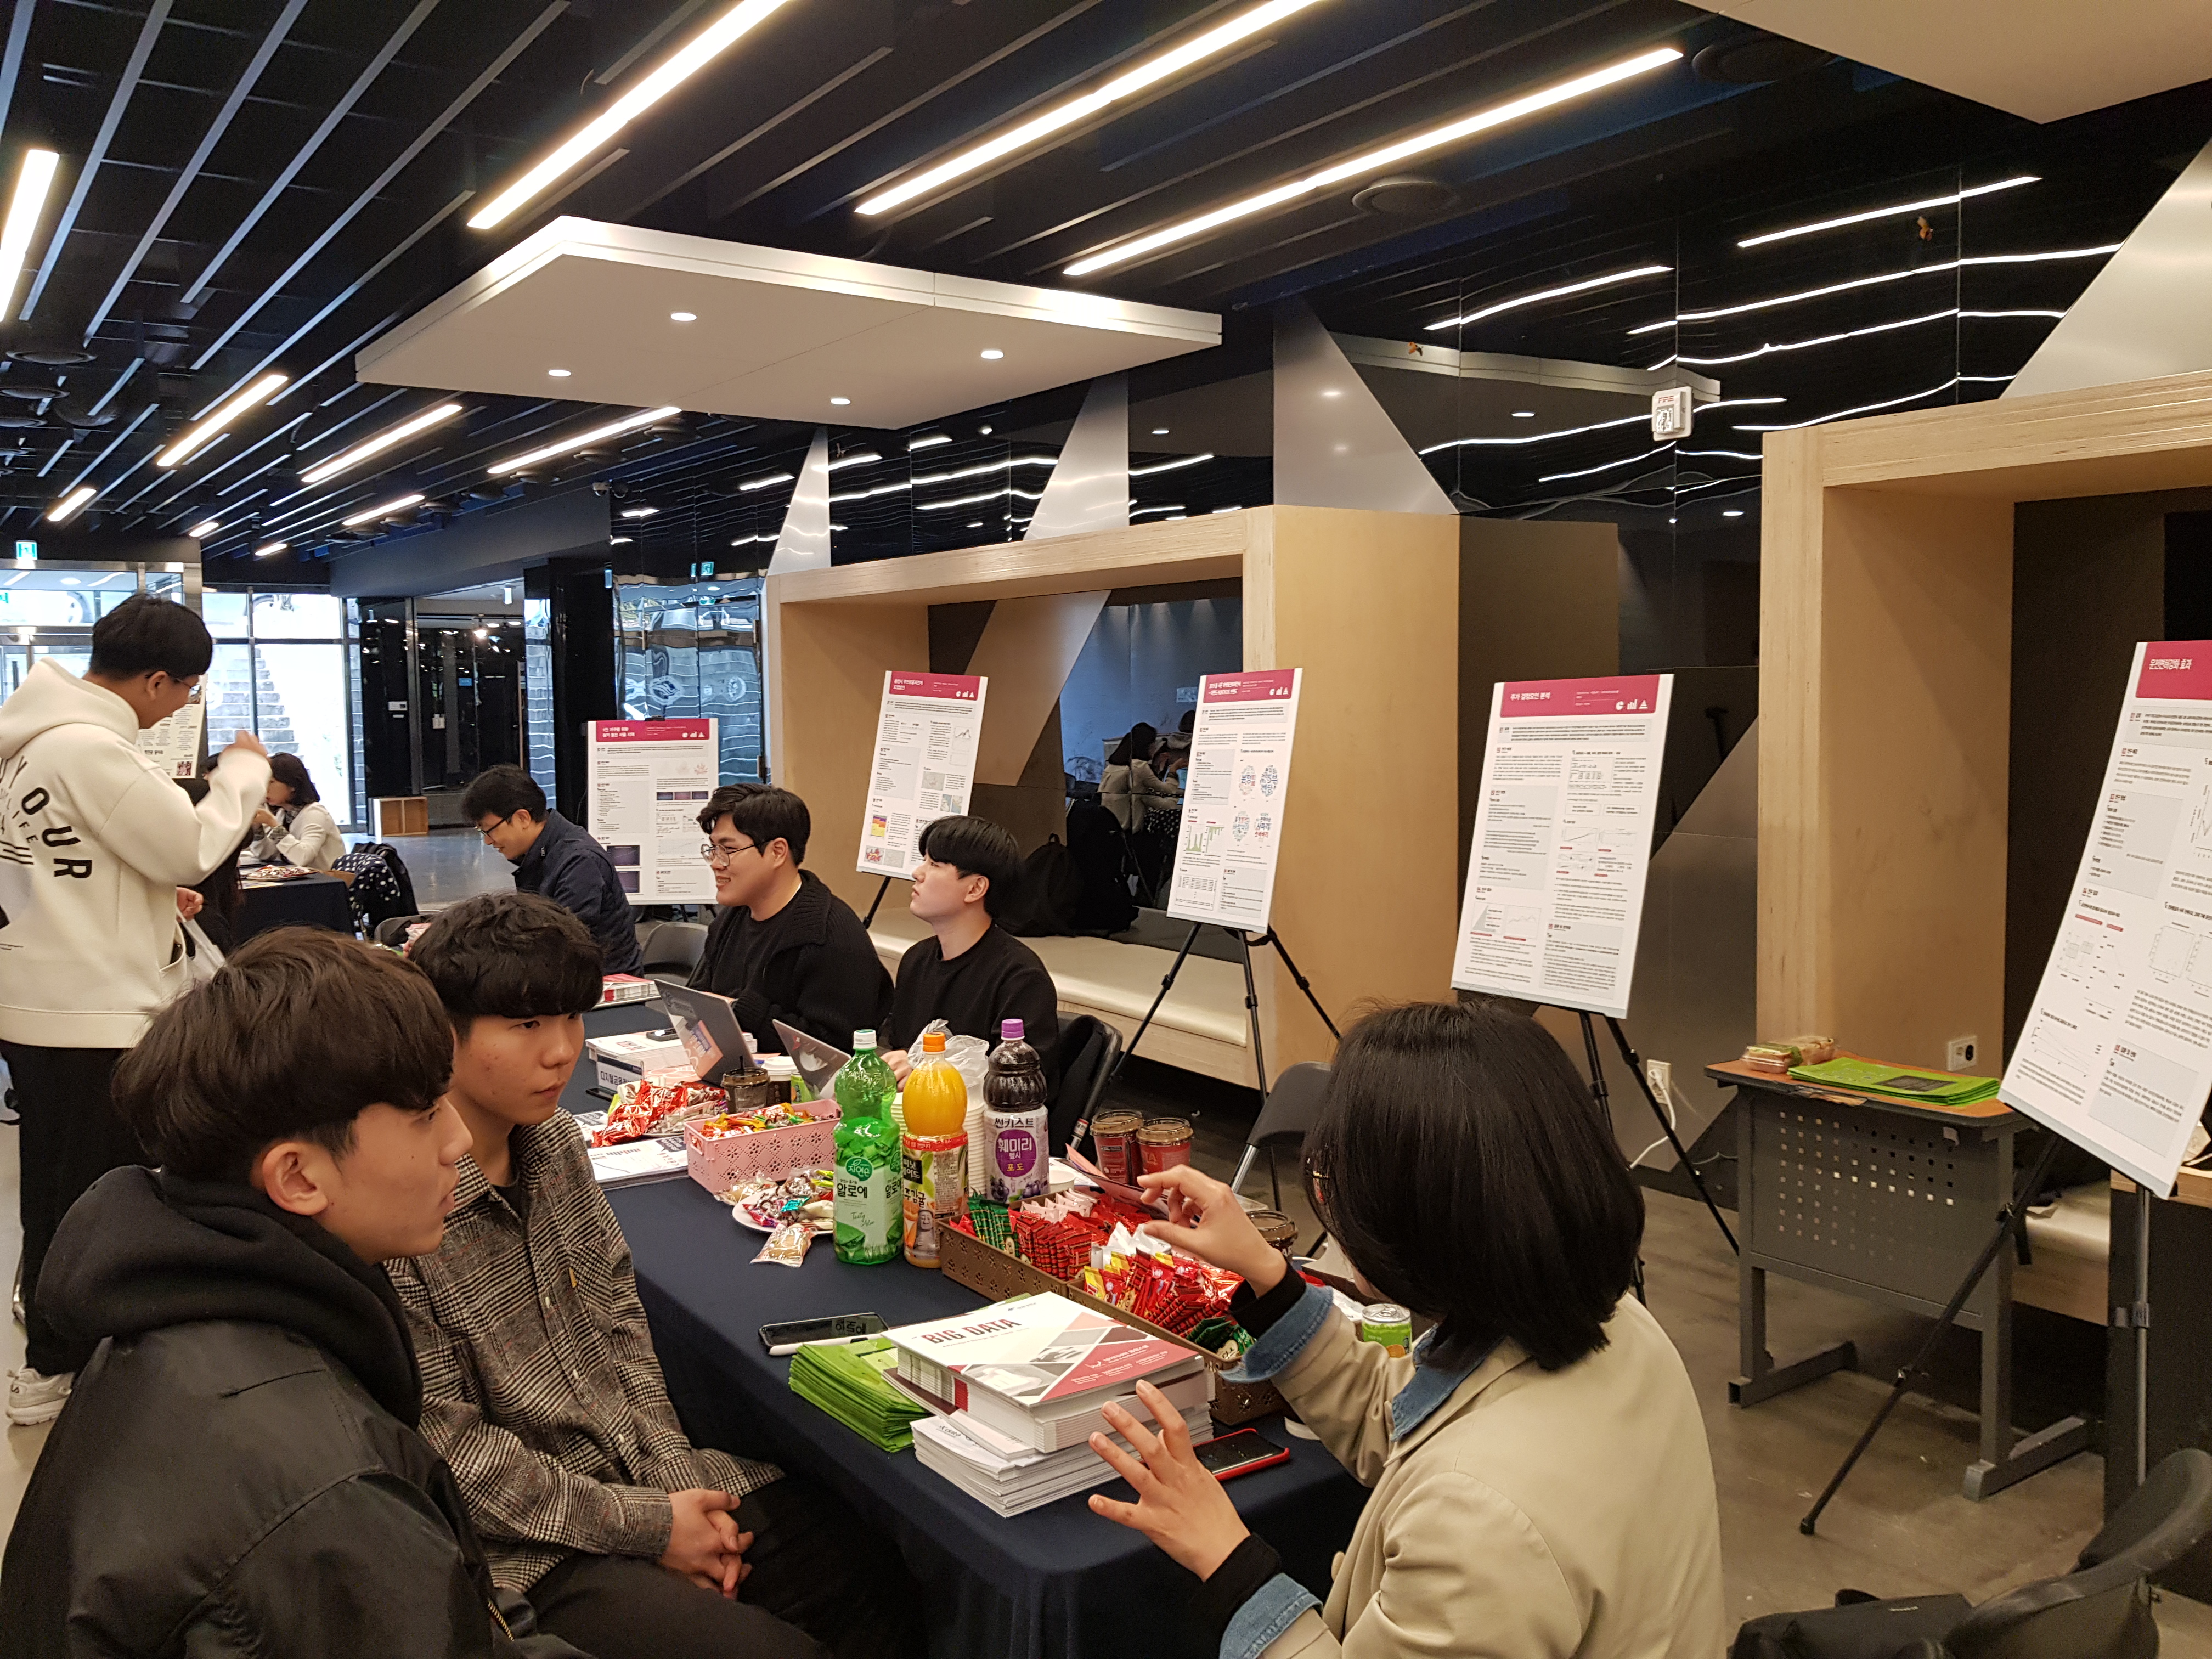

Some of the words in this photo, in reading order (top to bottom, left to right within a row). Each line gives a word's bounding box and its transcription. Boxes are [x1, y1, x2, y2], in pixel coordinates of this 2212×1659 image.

[1658, 395, 1674, 404] FIRE
[998, 1137, 1032, 1153] 훼미리
[837, 1183, 868, 1199] 알로에
[920, 1330, 967, 1344] BIG
[961, 1319, 1022, 1336] DATA
